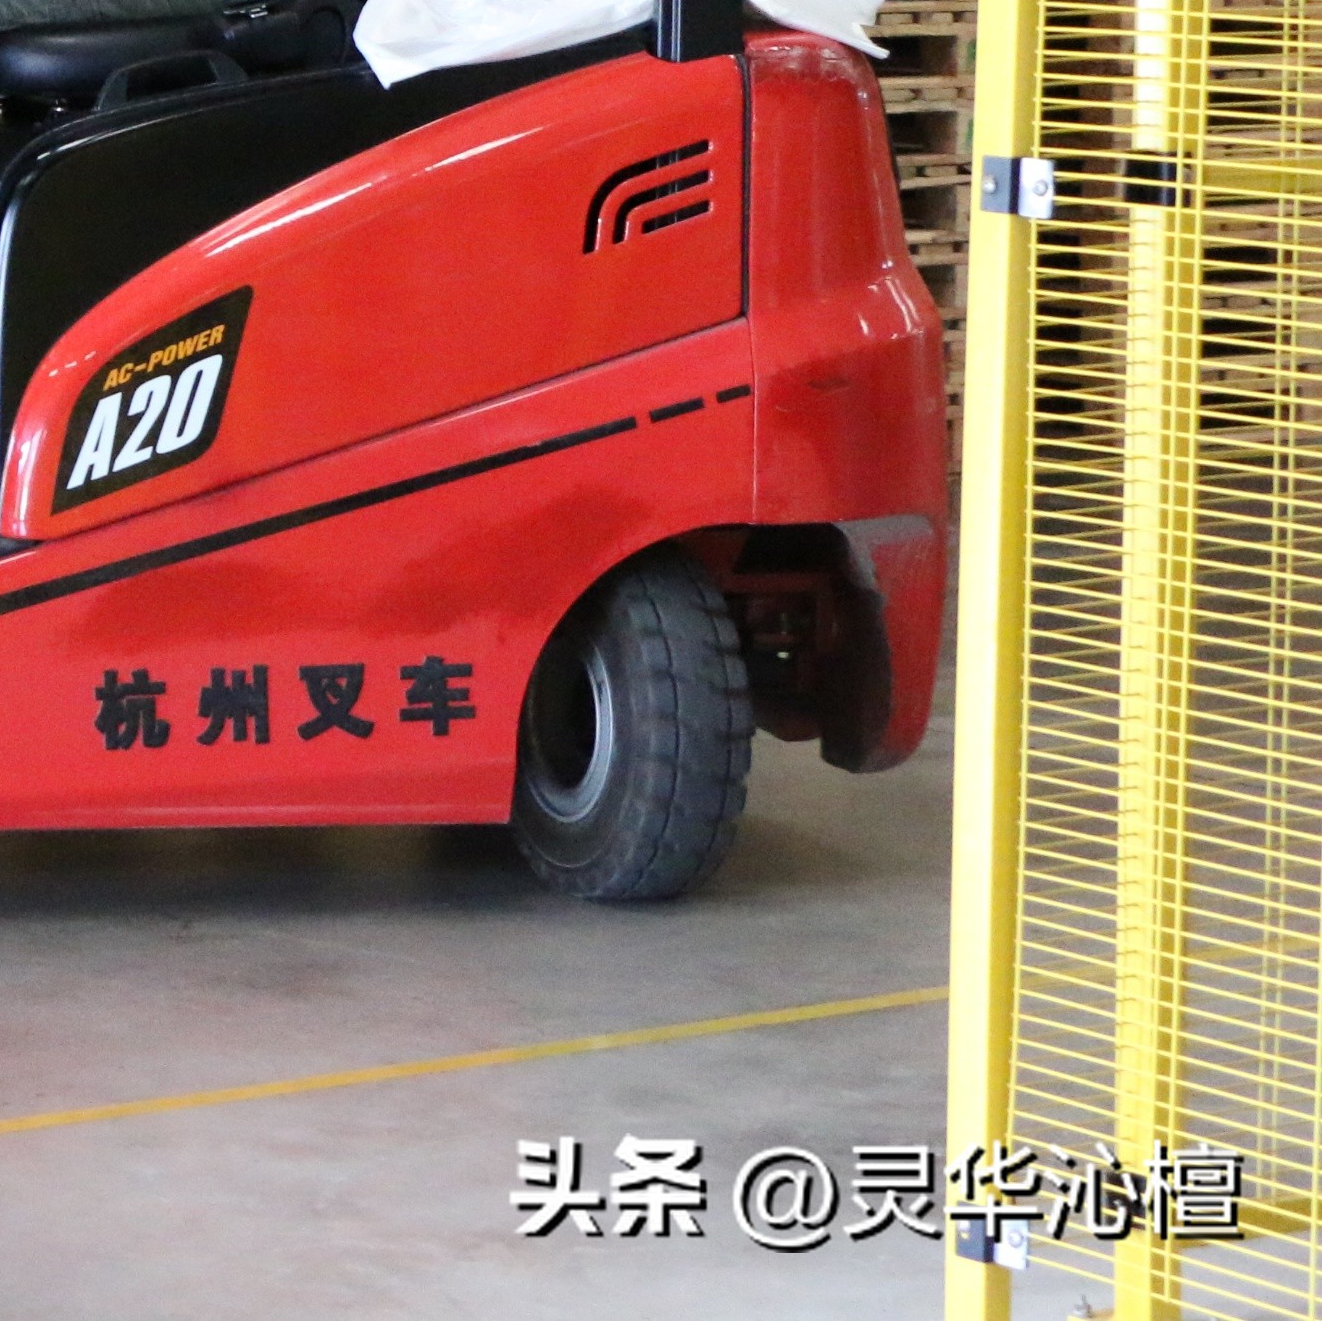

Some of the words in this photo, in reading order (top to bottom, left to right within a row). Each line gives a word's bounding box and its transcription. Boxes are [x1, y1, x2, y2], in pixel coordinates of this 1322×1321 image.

[103, 324, 225, 391] AC-POWER
[66, 354, 222, 489] A20
[95, 655, 475, 750] 杭州叉车
